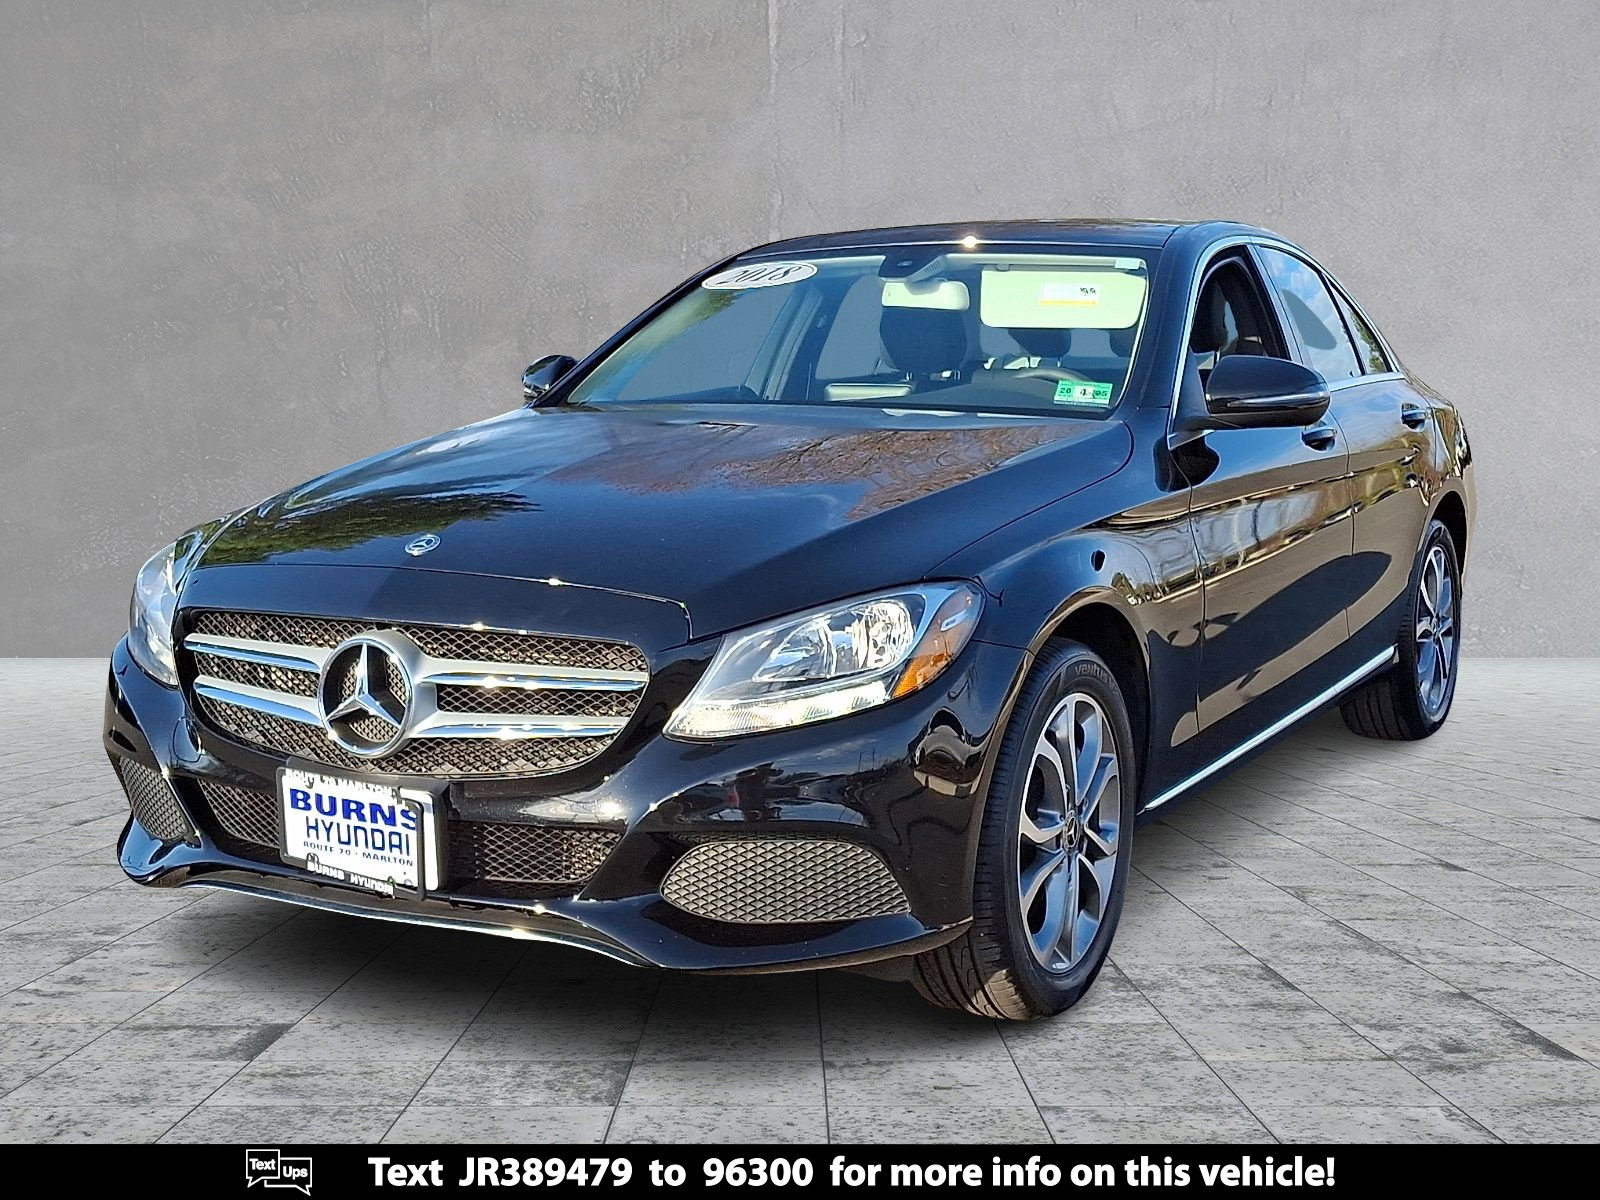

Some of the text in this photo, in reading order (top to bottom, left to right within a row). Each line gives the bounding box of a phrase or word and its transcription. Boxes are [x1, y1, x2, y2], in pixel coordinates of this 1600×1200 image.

[715, 266, 803, 285] 2018
[289, 788, 417, 831] BURNS
[305, 815, 411, 857] HYUNDAI
[303, 841, 414, 867] ROUTE 70 MARLTON
